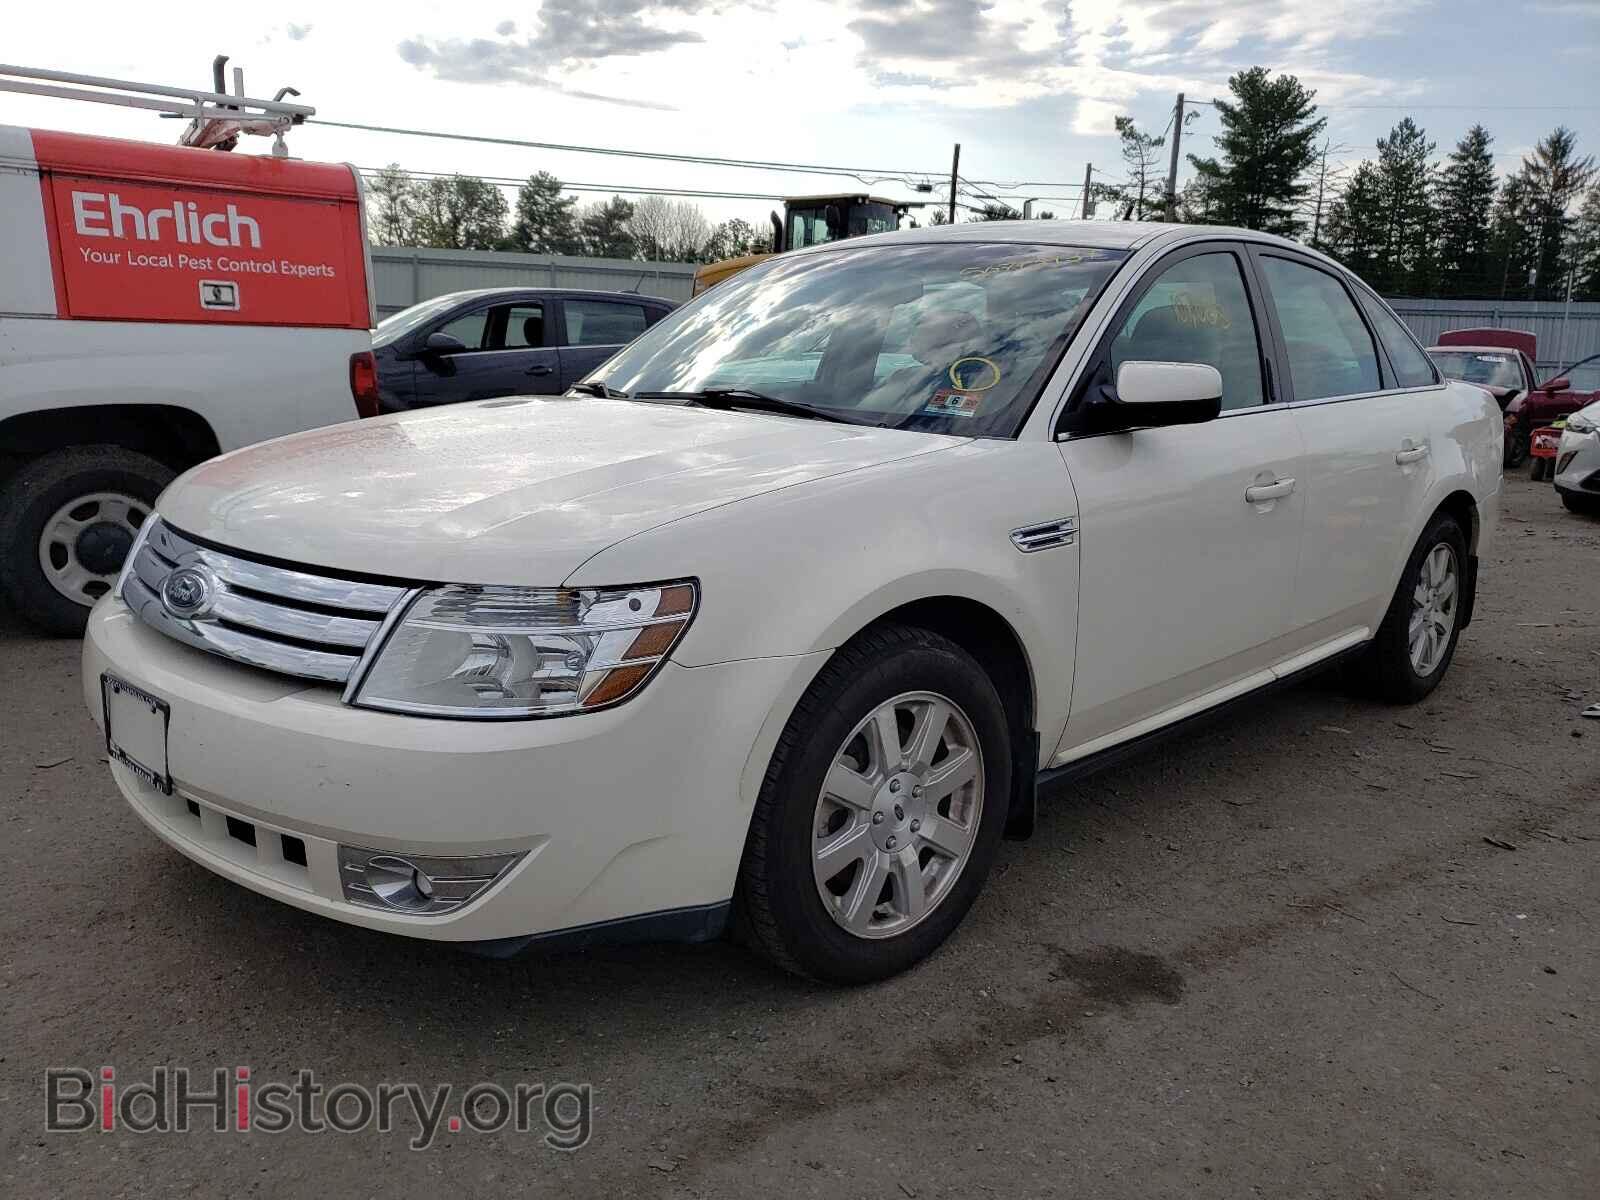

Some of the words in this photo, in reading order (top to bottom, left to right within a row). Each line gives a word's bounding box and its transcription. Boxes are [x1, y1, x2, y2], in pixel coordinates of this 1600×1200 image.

[71, 190, 262, 248] Ehrlich
[80, 247, 121, 264] Your
[127, 250, 174, 269] Local
[178, 254, 213, 271] Pest
[216, 256, 278, 275] Control
[281, 260, 336, 279] Experts
